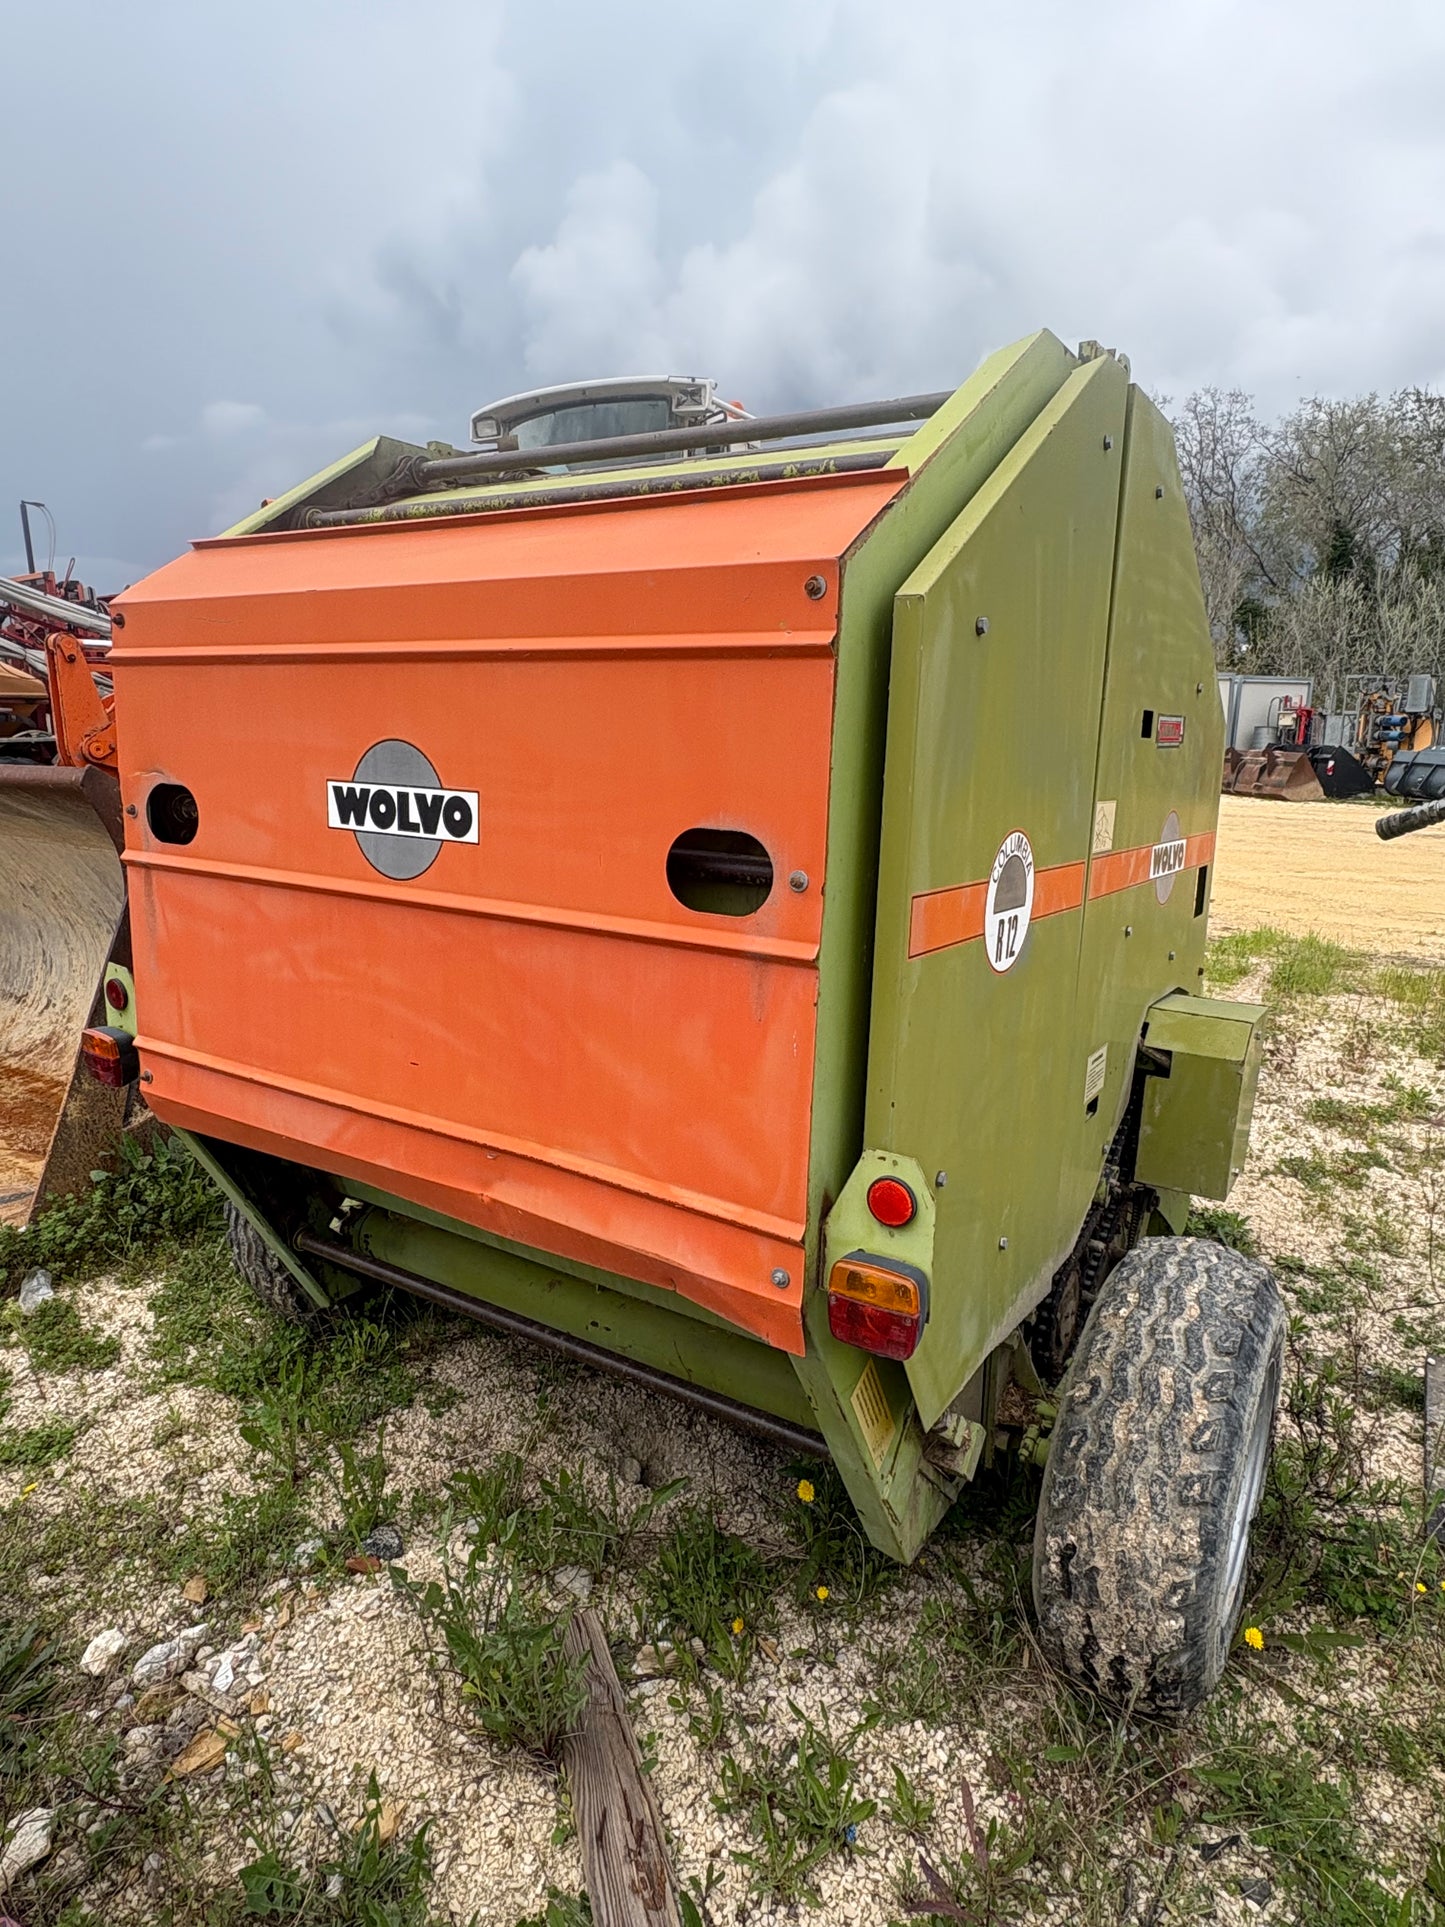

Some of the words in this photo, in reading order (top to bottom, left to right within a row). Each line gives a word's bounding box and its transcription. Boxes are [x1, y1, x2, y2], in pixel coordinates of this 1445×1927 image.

[332, 785, 473, 838] WOLVO
[992, 834, 1033, 883] COLUMBIA
[1153, 842, 1184, 876] WOLVO
[994, 918, 1005, 963] R
[1005, 914, 1019, 959] 12
